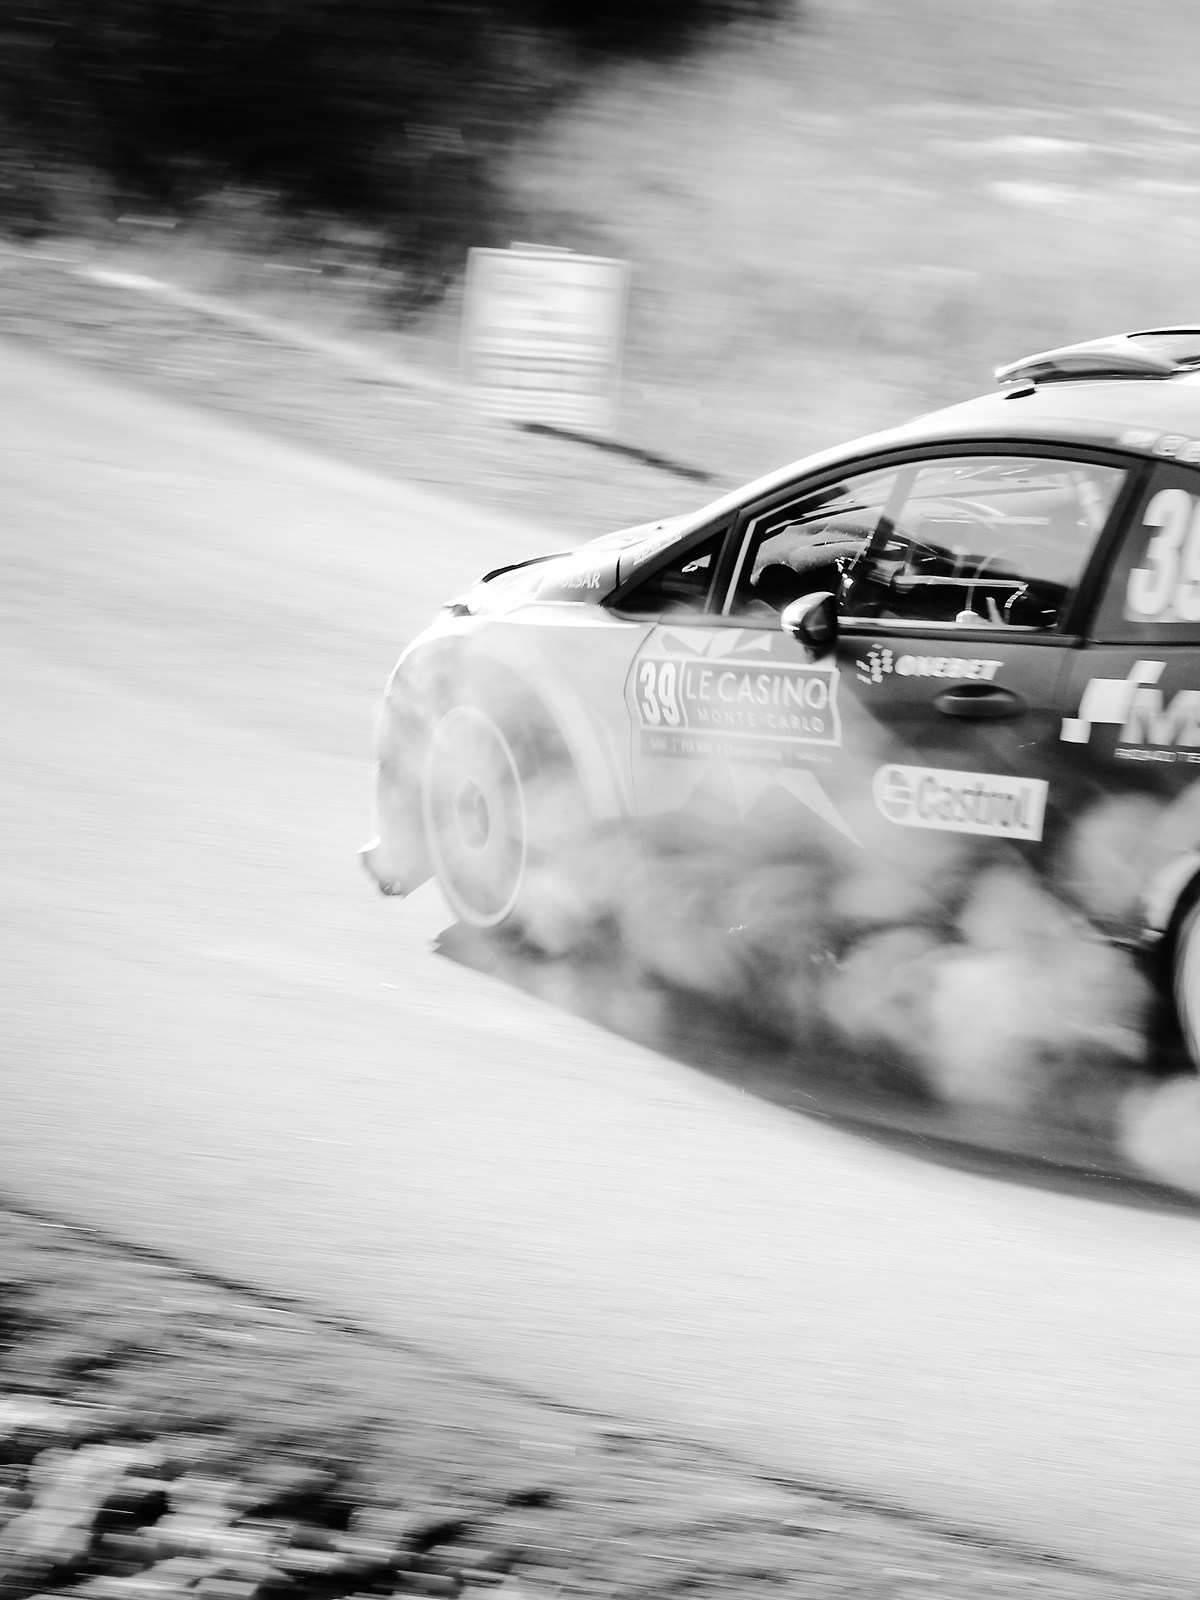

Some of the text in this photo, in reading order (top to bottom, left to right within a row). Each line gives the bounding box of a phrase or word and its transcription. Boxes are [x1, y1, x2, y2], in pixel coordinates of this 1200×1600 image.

[639, 660, 681, 726] 39
[686, 668, 828, 710] LE CASINO
[917, 775, 1033, 830] Castrol
